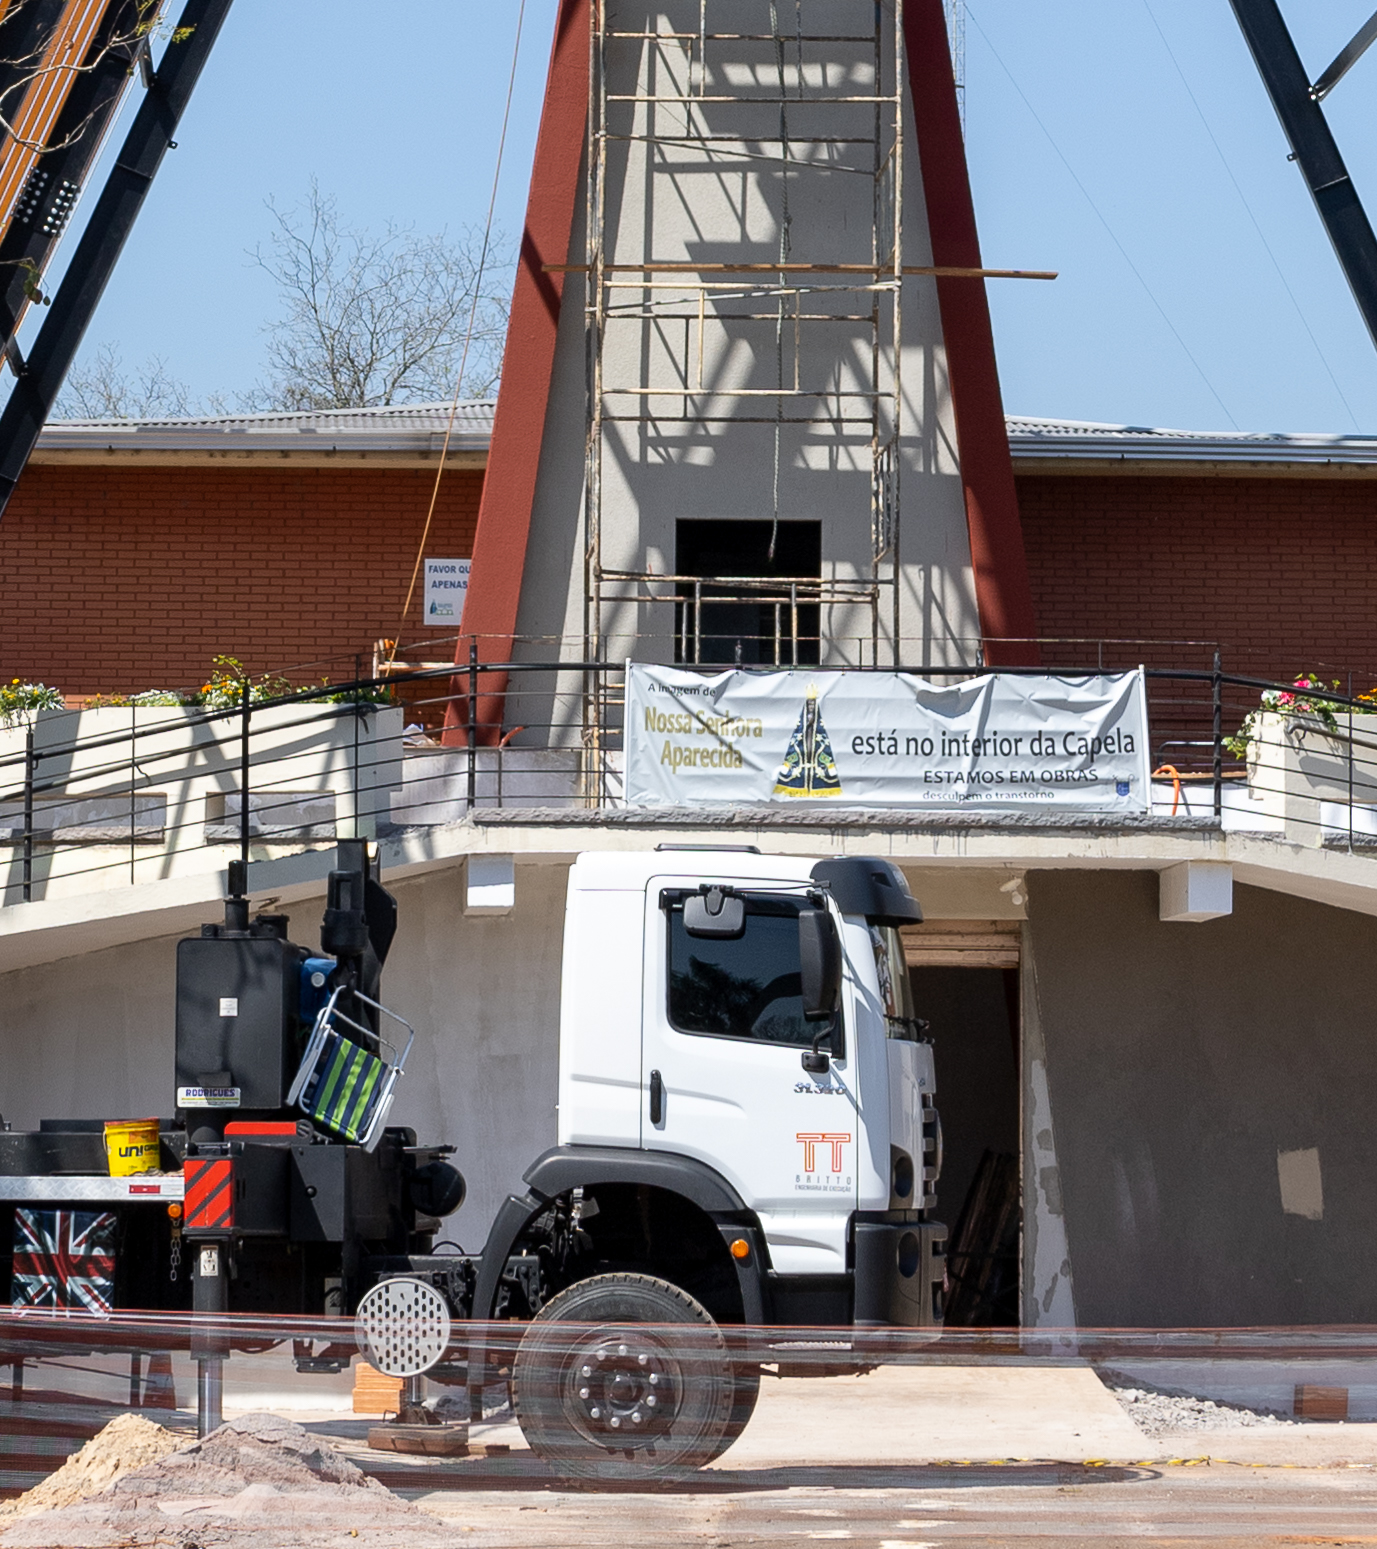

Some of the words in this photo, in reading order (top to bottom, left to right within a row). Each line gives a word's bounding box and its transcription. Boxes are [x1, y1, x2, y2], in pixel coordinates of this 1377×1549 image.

[428, 565, 457, 574] FAVOR
[432, 580, 468, 590] APENAS
[647, 682, 656, 692] A
[658, 682, 700, 697] imagem
[703, 686, 716, 697] de
[644, 706, 692, 734] Nossa
[696, 709, 763, 738] Senhora
[851, 728, 898, 755] está
[905, 736, 934, 756] no
[941, 730, 1023, 757] interior
[1029, 730, 1056, 756] da
[1062, 727, 1135, 763] Capela
[660, 740, 743, 775] Aparecida
[923, 770, 1005, 784] ESTAMOS
[1009, 770, 1036, 783] EM
[1040, 768, 1099, 783] OBRAS
[922, 790, 983, 805] desculpem
[995, 790, 1055, 800] transtorno
